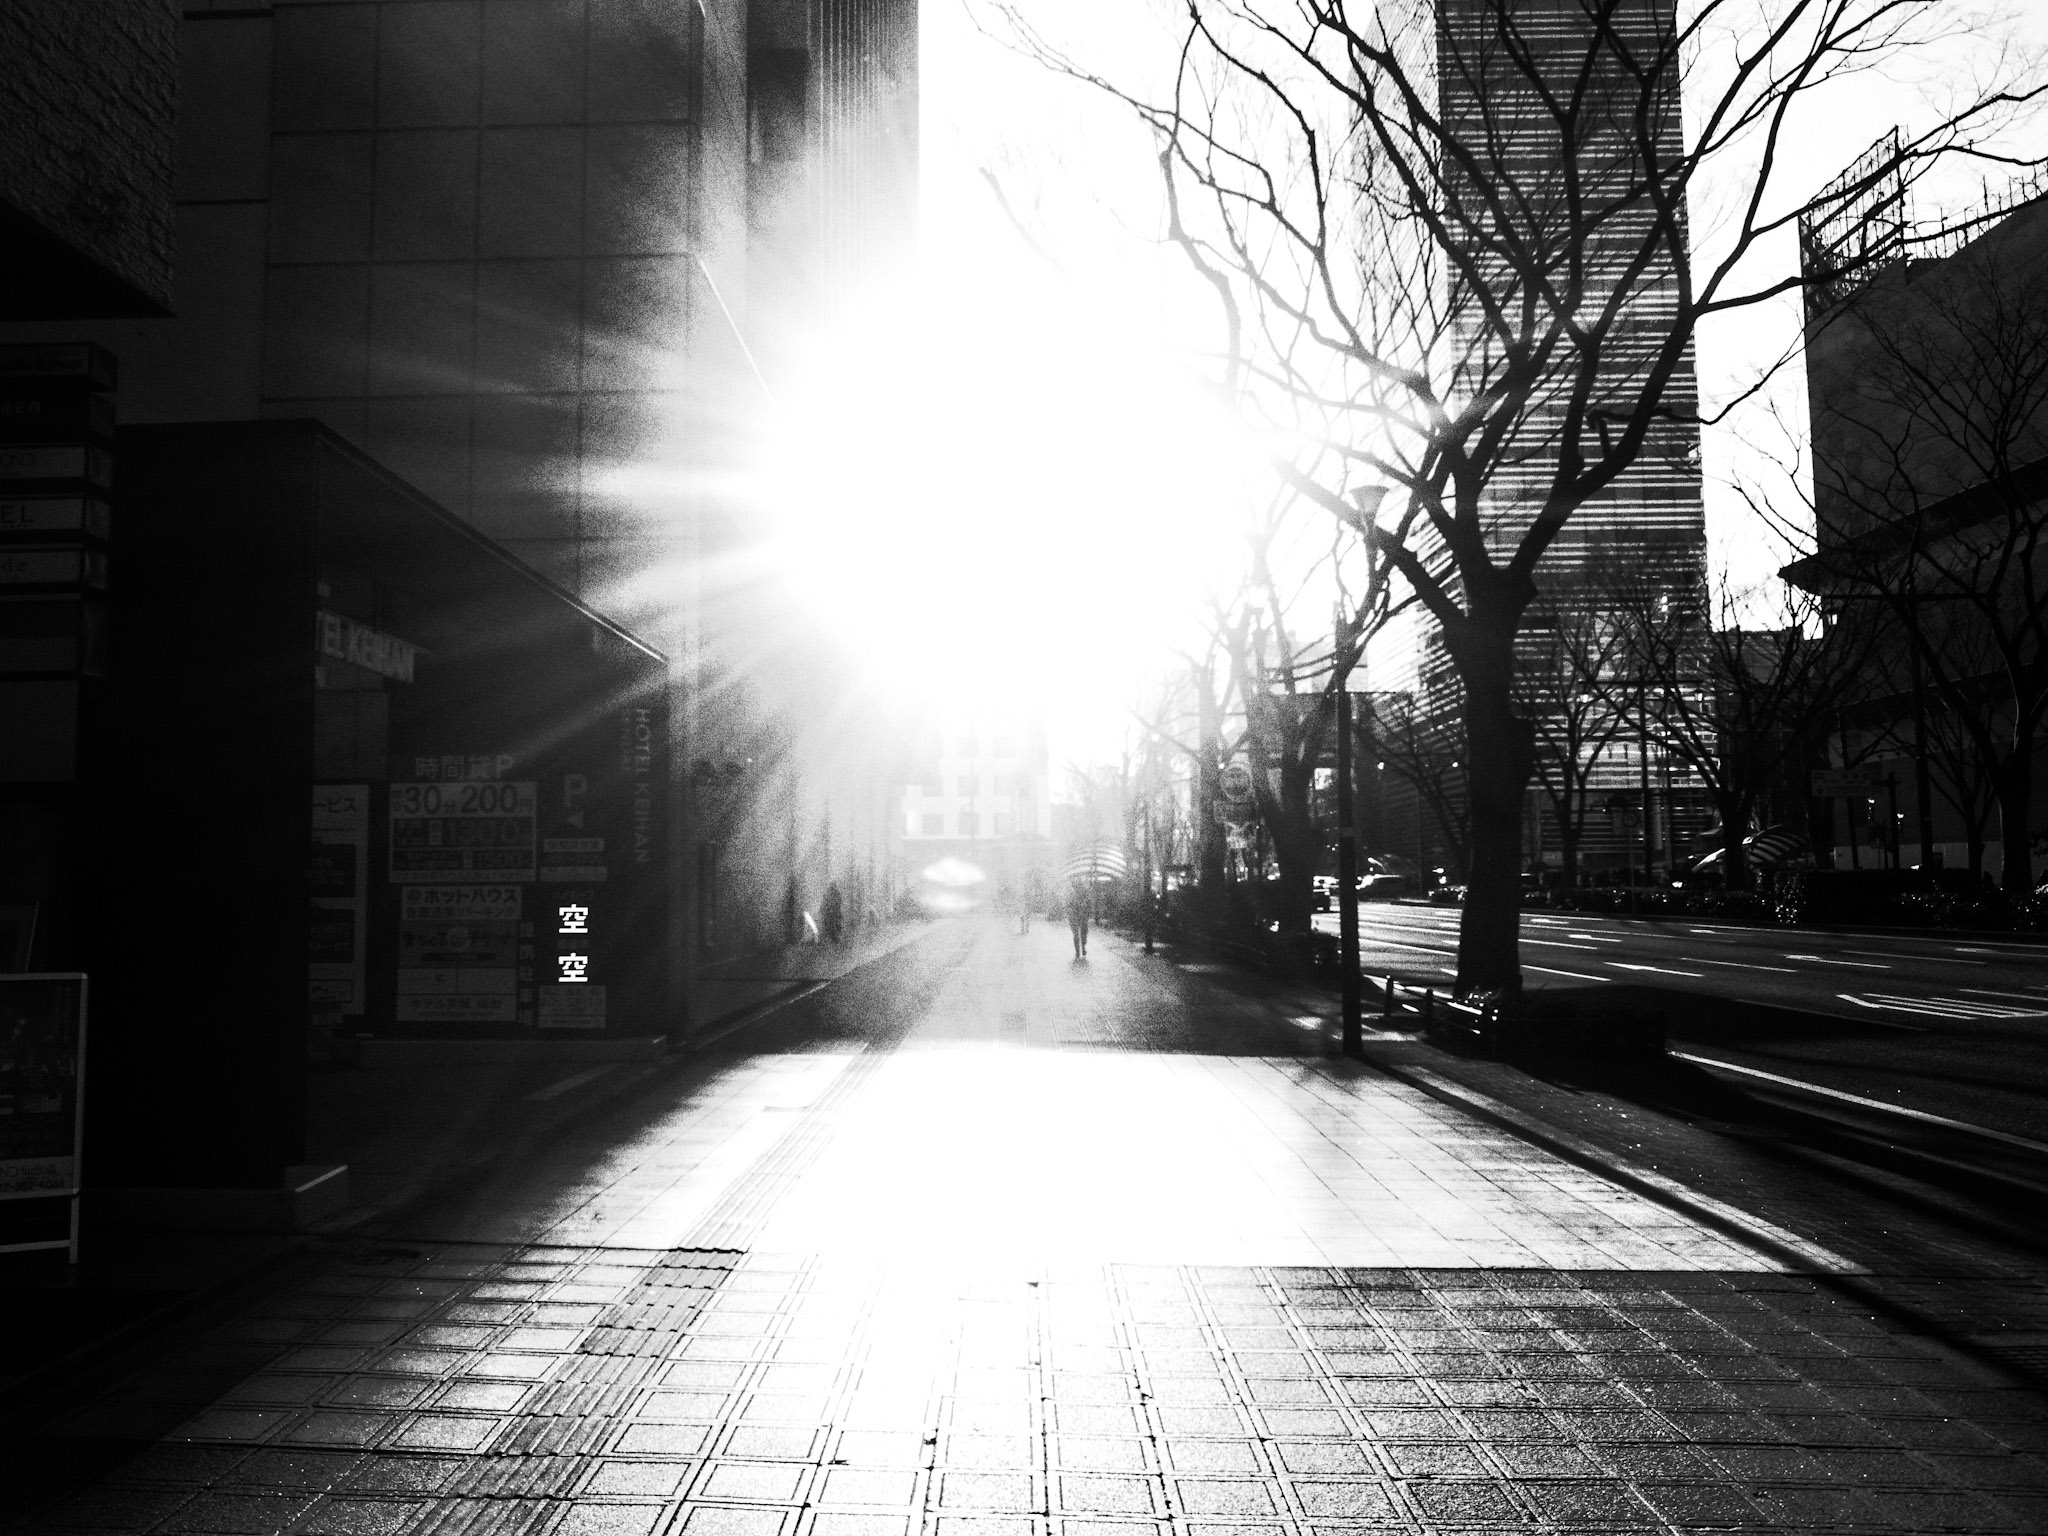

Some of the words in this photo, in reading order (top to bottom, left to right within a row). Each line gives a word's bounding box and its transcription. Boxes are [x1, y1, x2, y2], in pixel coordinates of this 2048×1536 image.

[564, 773, 588, 808] P
[558, 903, 589, 934] 空
[558, 952, 589, 983] 空
